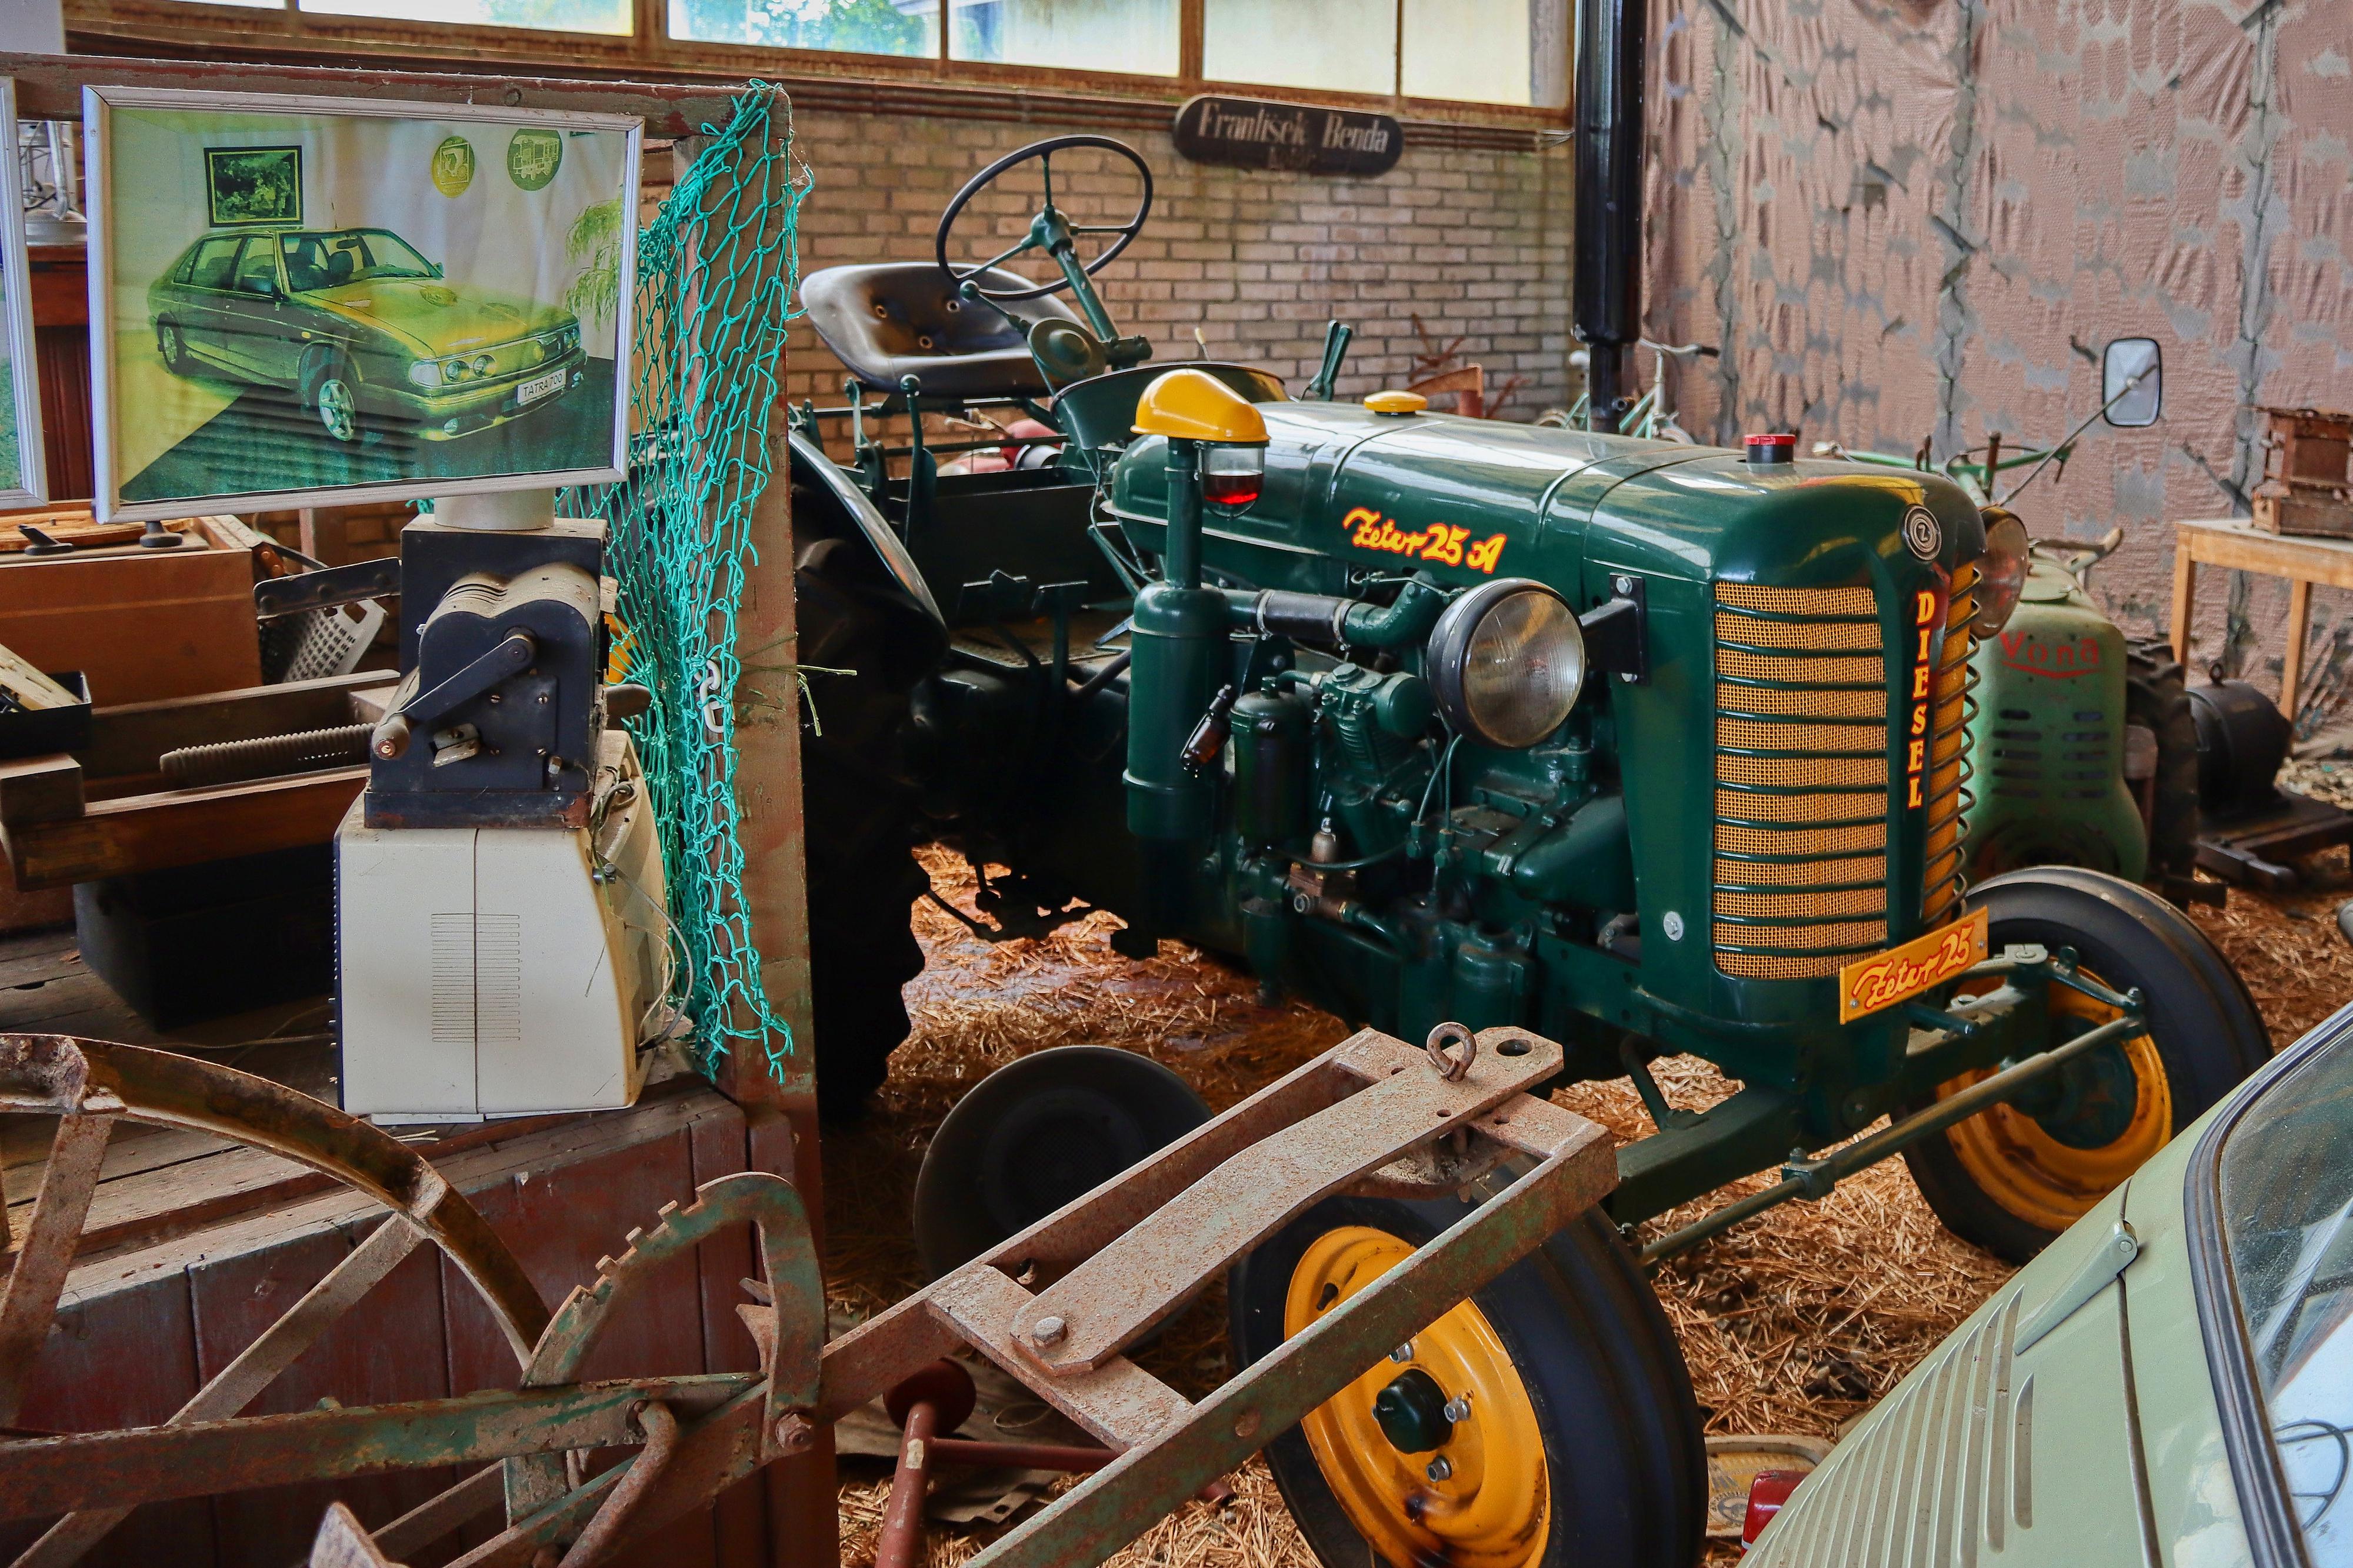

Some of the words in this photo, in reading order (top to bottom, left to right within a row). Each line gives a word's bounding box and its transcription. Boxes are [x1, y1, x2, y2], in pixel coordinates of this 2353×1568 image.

[523, 380, 548, 397] TATRA
[549, 373, 562, 386] 700
[1342, 507, 1428, 557] Zetor
[1421, 522, 1471, 567] 25
[1999, 630, 2100, 666] Vona
[1907, 590, 1936, 810] DIESEL
[1852, 953, 1941, 1010] Zetor
[1937, 923, 1975, 976] 25
